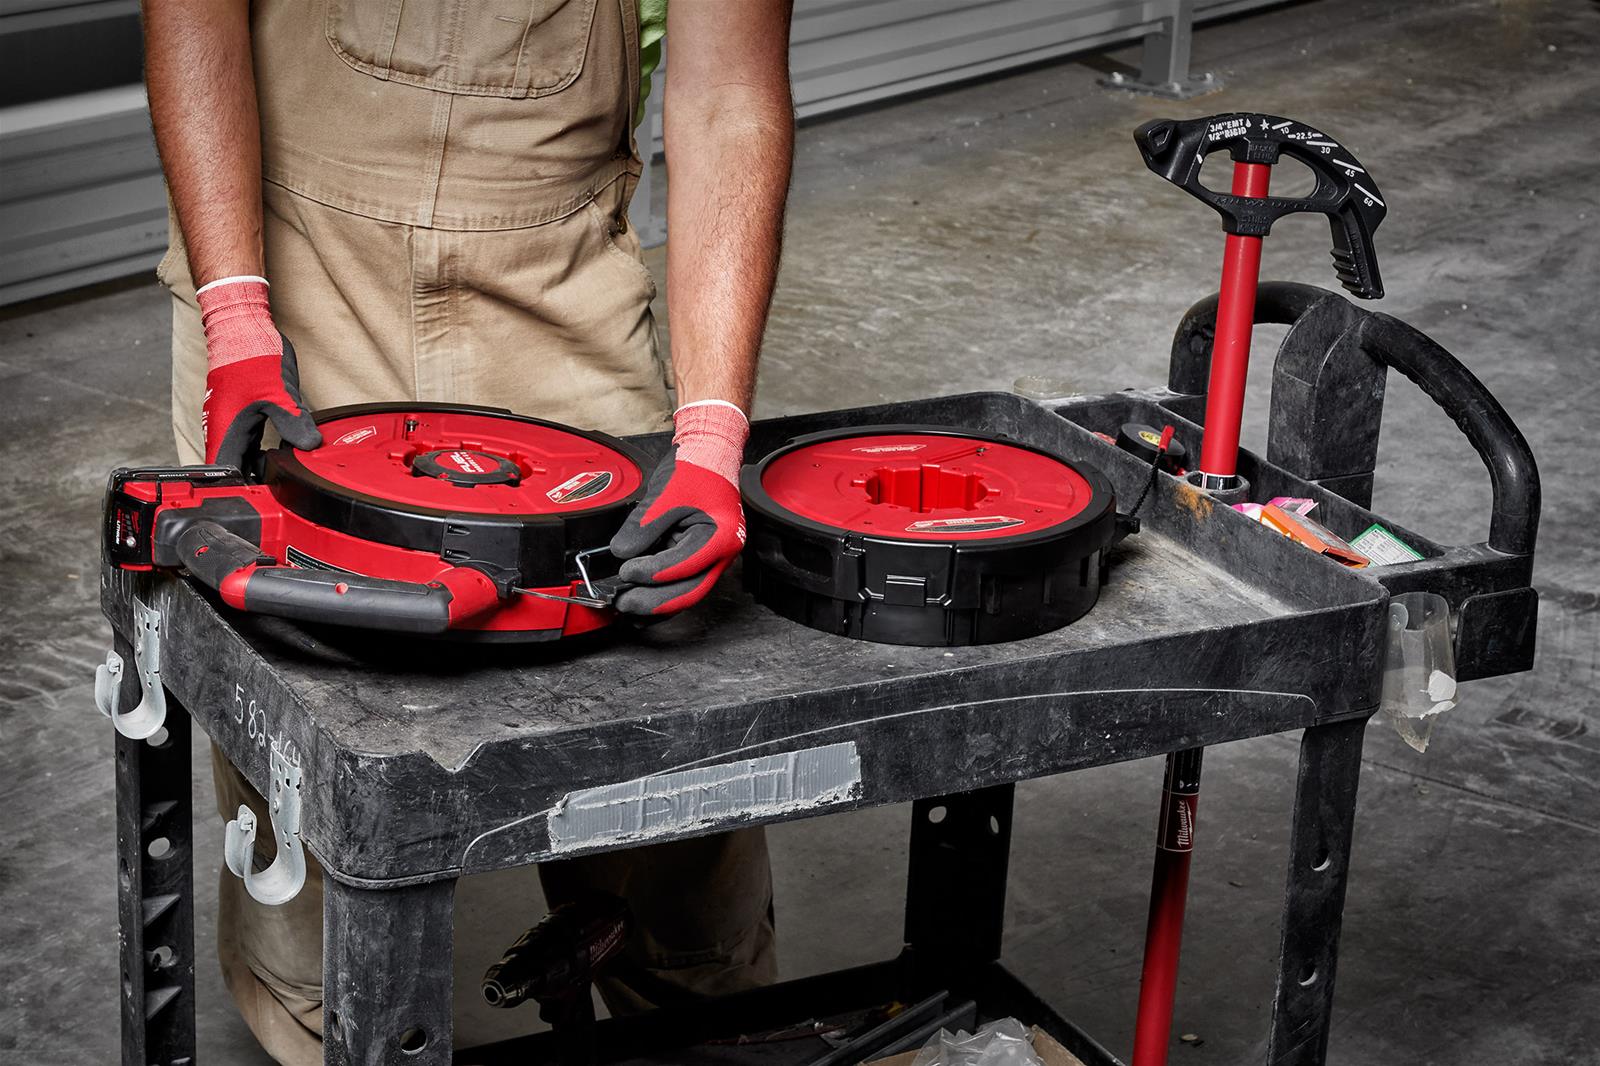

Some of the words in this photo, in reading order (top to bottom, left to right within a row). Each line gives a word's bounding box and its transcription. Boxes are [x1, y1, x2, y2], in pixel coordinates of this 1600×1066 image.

[1280, 126, 1290, 134] 10
[1296, 131, 1312, 140] 22.5
[1321, 146, 1331, 154] 30
[1344, 168, 1356, 178] 45
[1363, 197, 1374, 207] 60
[1176, 800, 1190, 848] Milwaukee
